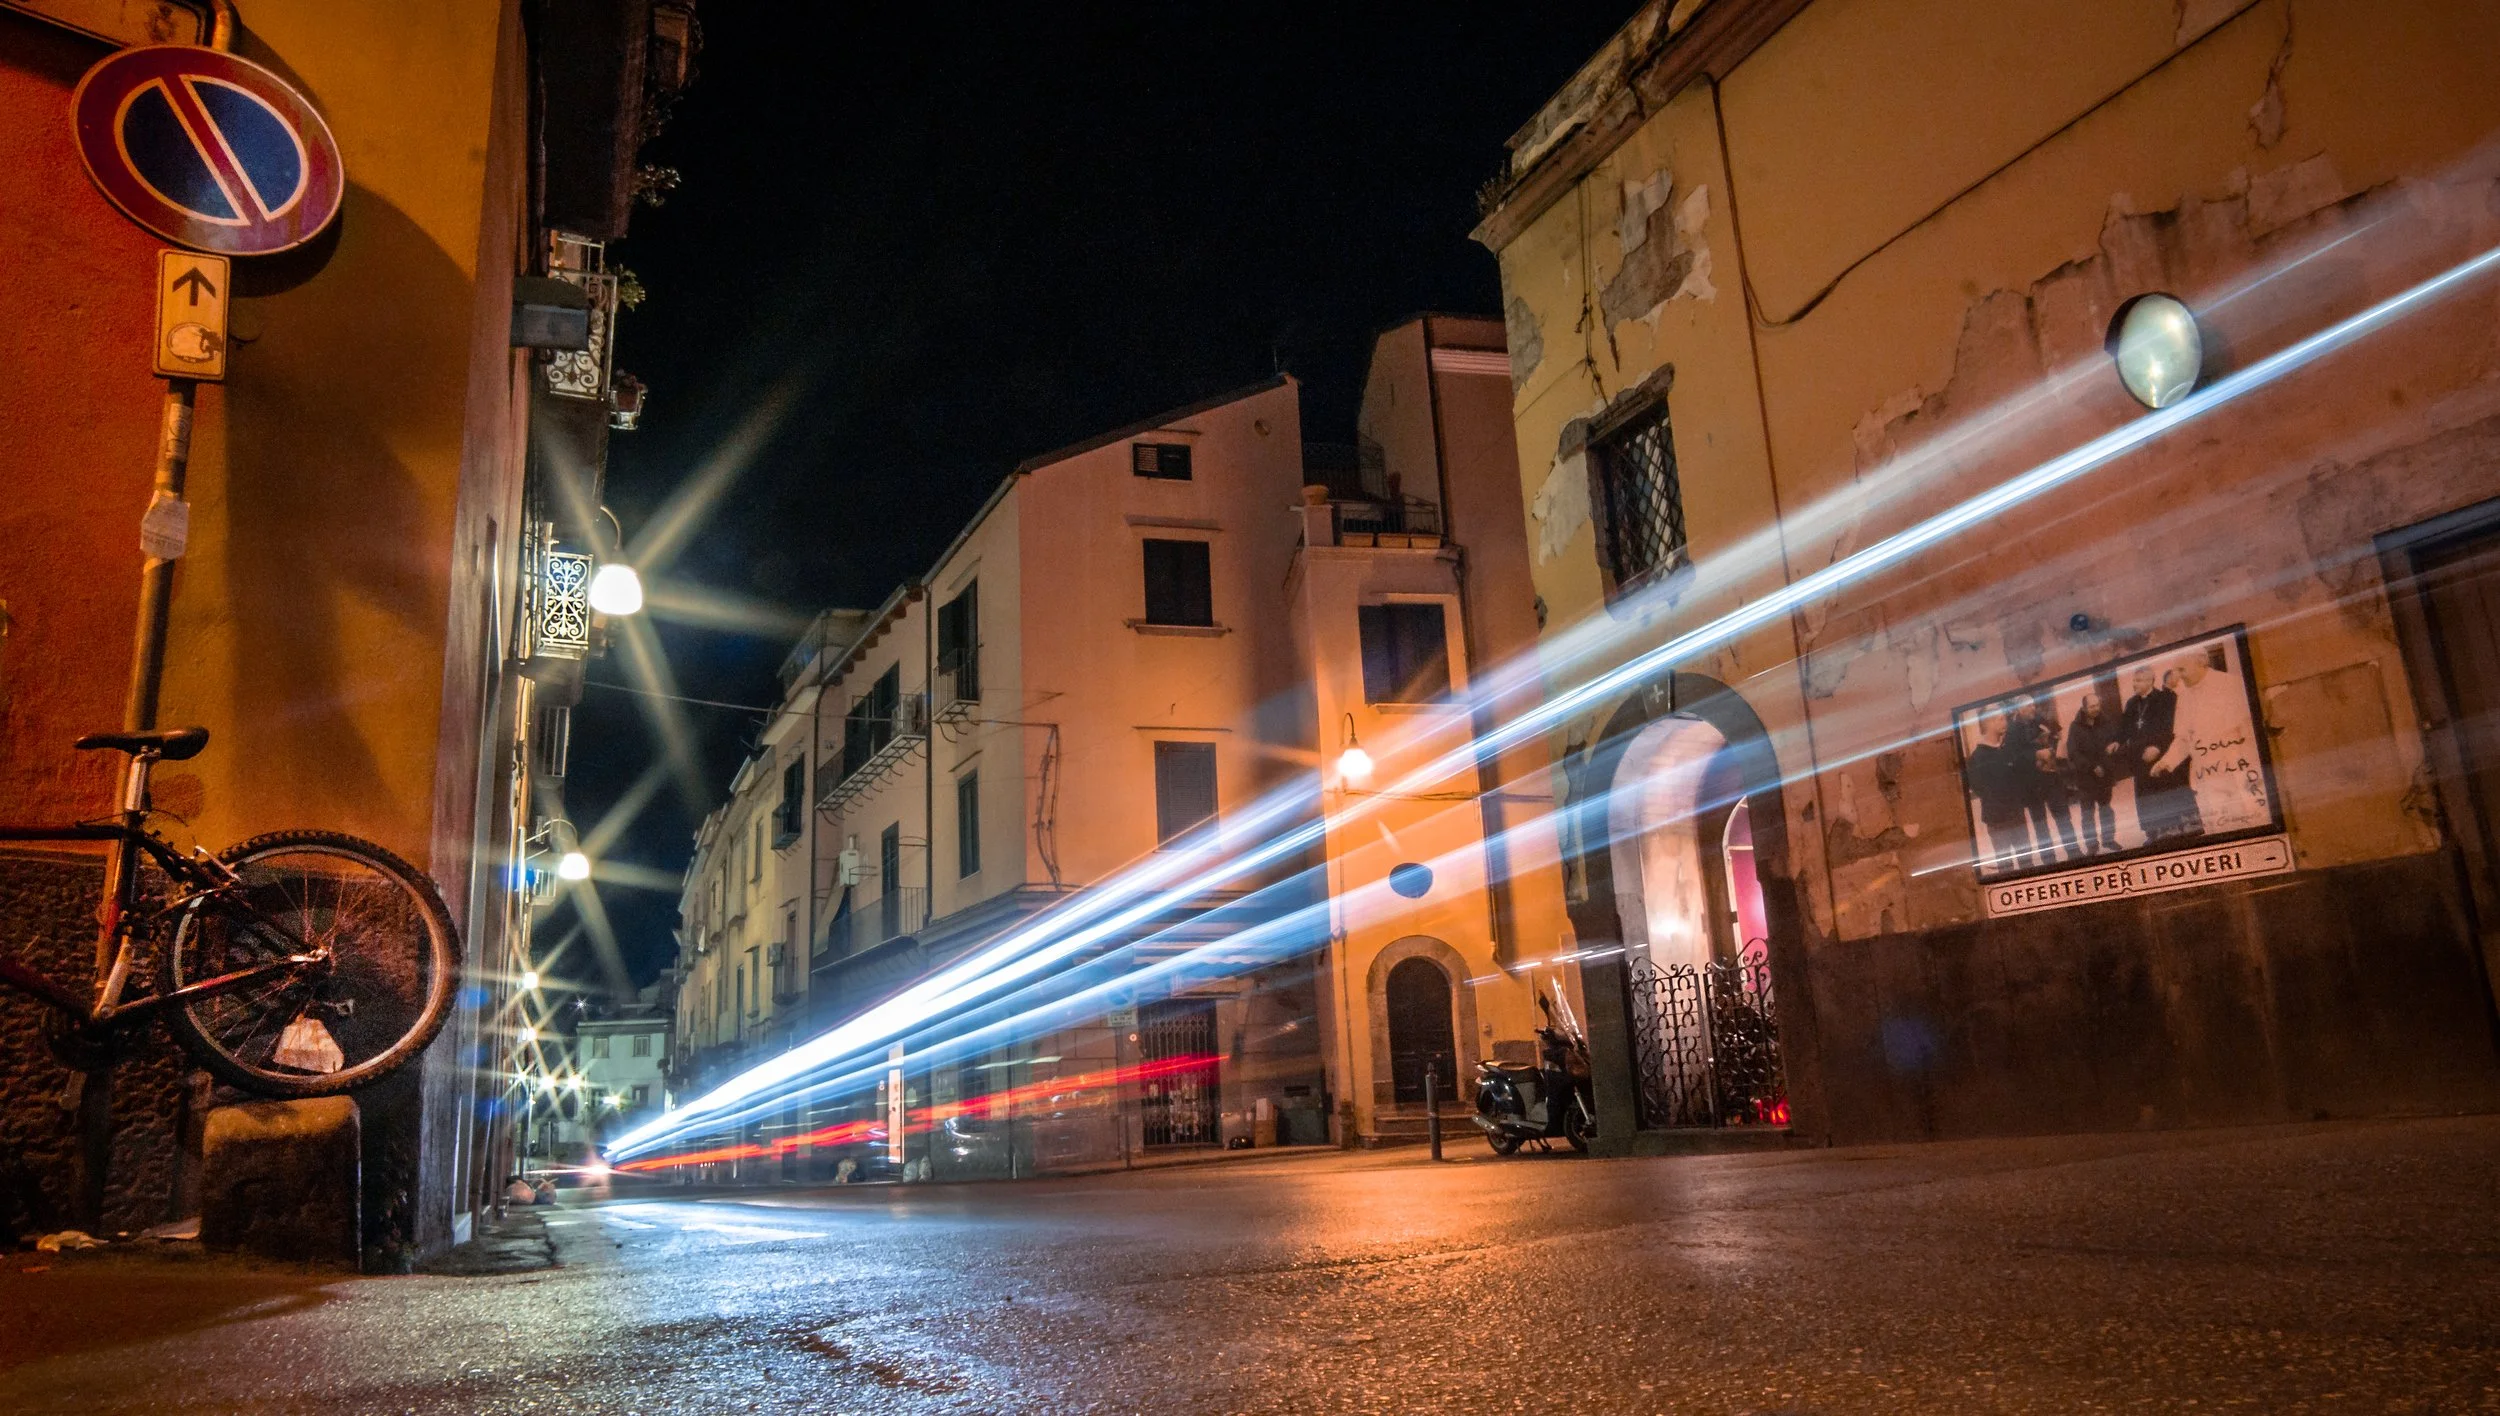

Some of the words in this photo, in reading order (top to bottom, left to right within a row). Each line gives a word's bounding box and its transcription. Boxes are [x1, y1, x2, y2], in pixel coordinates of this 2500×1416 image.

[2000, 879, 2086, 907] OFFERTE
[2093, 872, 2134, 892] PER
[2140, 868, 2147, 885] I
[2156, 852, 2243, 881] POVERI
